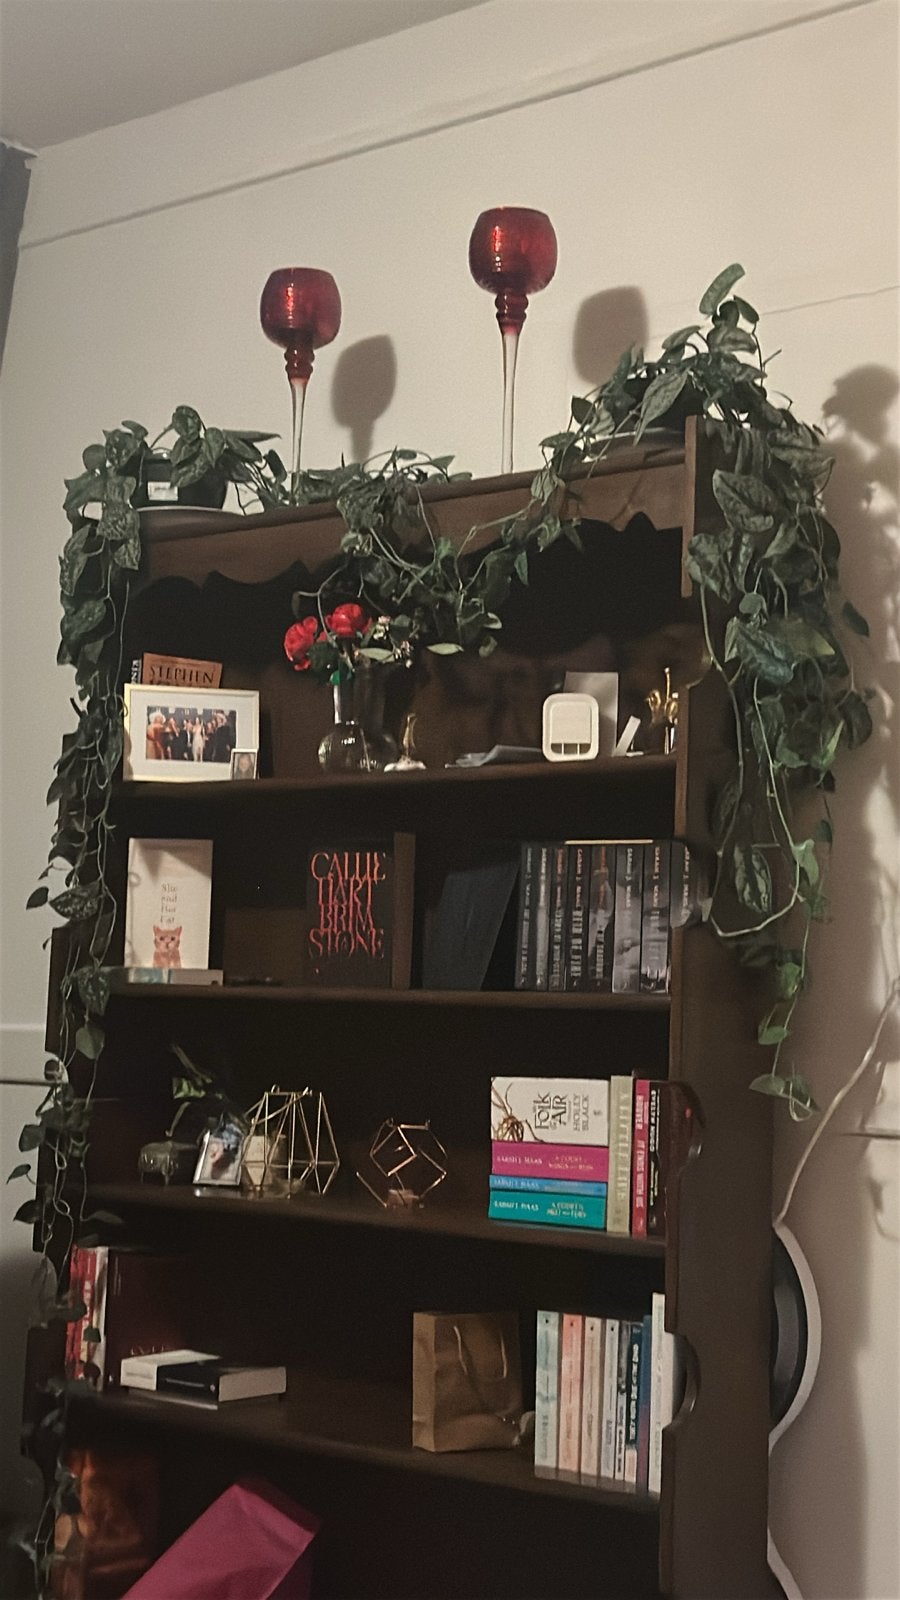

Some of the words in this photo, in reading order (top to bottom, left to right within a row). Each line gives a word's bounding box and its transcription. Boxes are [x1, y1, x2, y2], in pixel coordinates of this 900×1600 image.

[150, 665, 214, 684] STEPHEN
[310, 851, 386, 882] CALLIE
[318, 877, 372, 905] HART
[533, 1092, 551, 1129] FOLK
